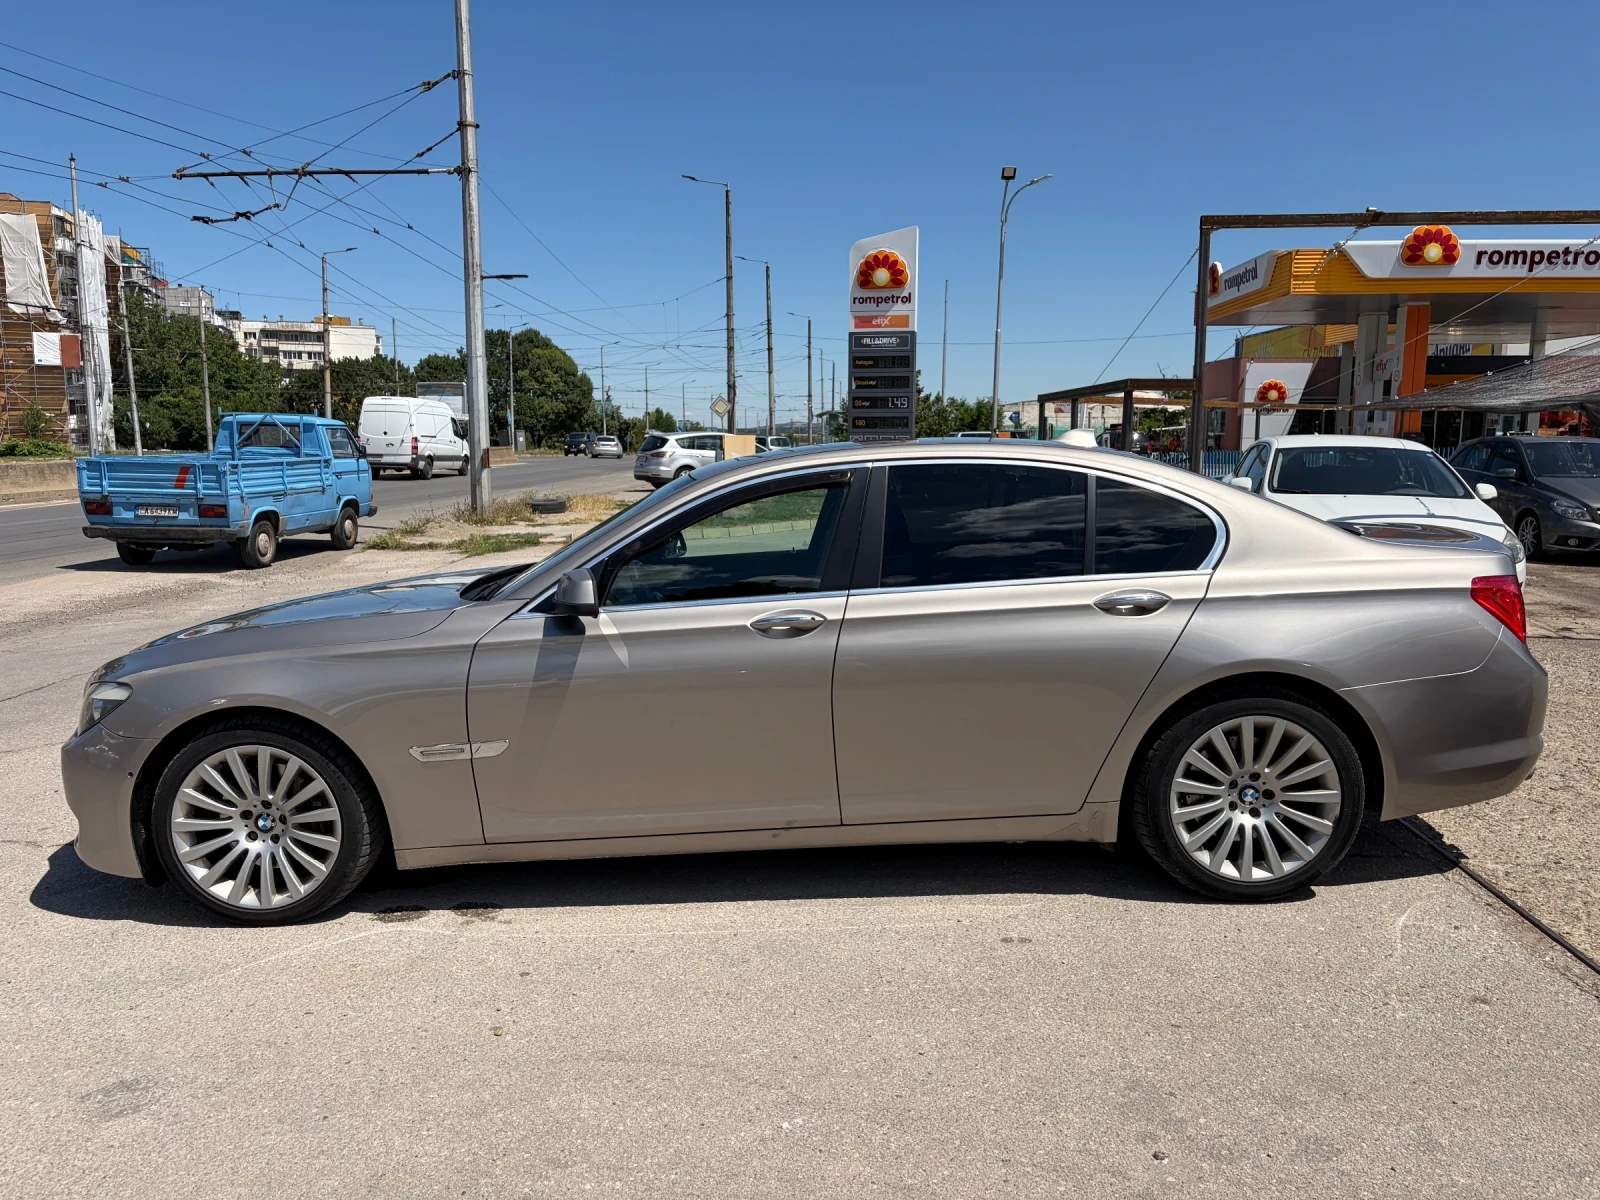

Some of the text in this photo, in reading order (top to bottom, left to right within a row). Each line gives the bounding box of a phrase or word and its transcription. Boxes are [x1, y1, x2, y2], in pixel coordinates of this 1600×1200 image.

[1223, 259, 1258, 292] rompetrol
[853, 292, 911, 307] rompetrol
[1375, 359, 1389, 374] efix
[888, 397, 908, 408] 1.49
[855, 419, 866, 427] 100
